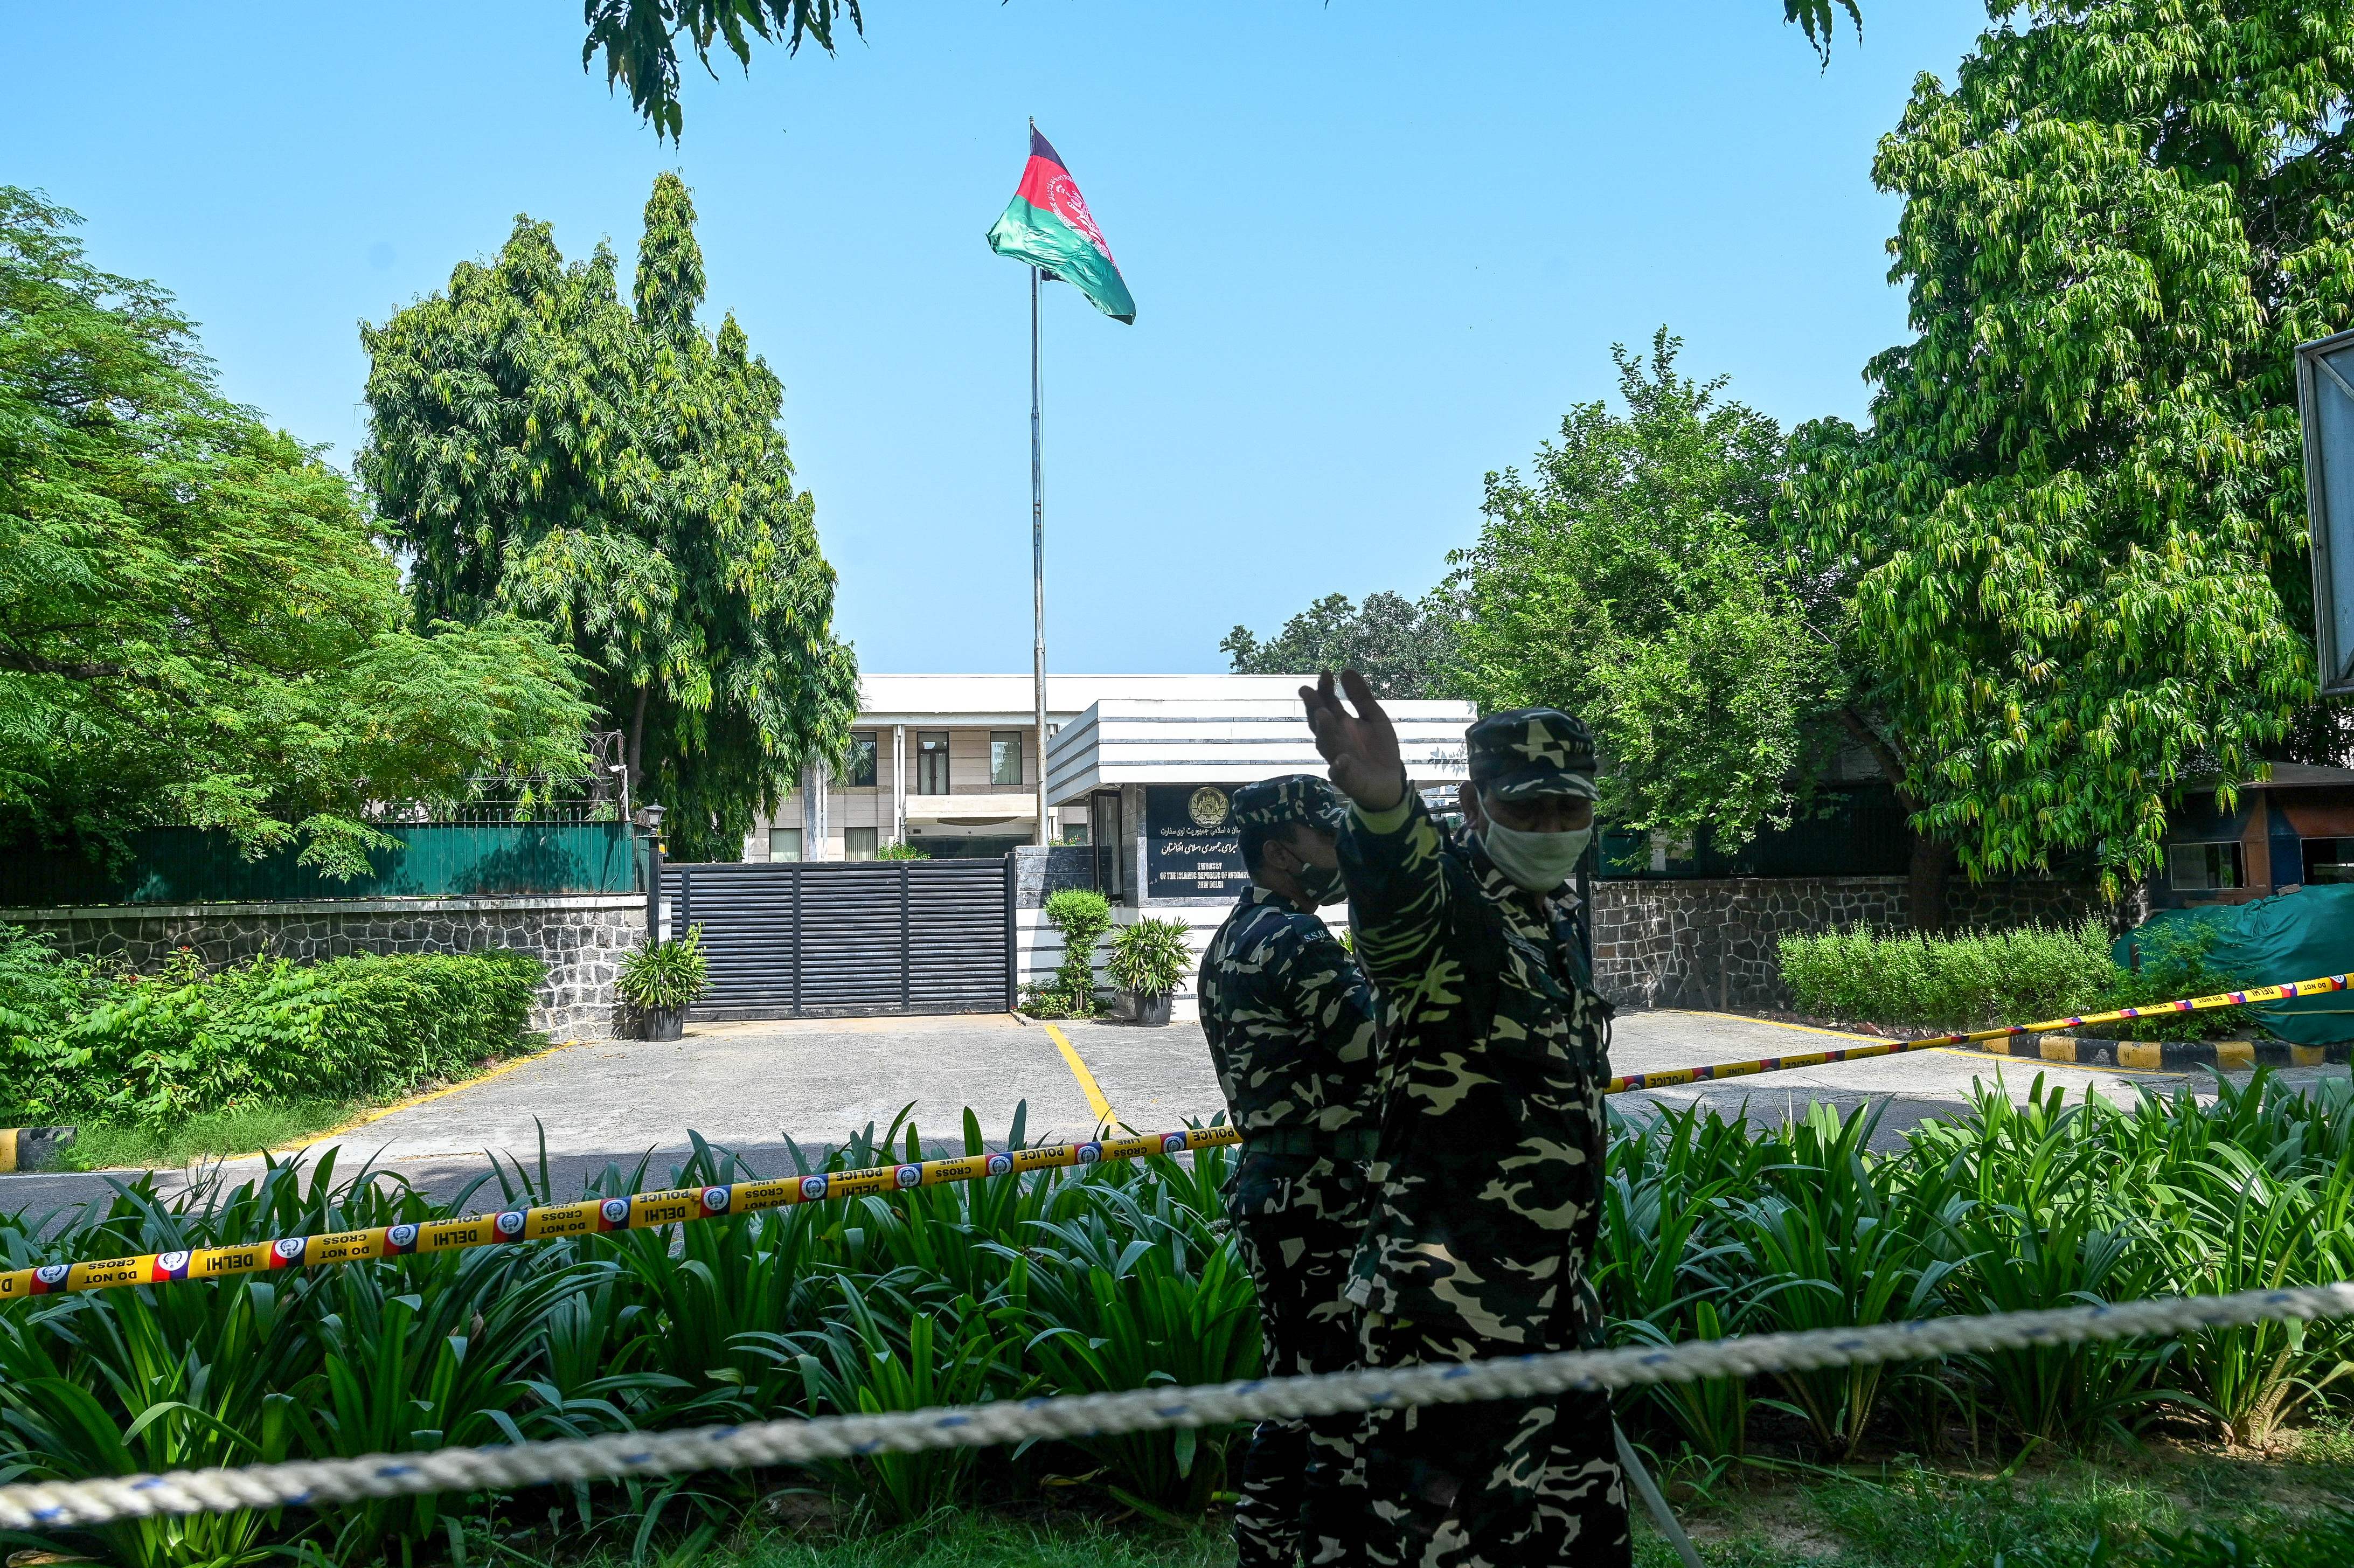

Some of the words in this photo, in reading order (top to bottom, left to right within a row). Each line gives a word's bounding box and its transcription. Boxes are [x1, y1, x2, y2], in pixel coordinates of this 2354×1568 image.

[1197, 862, 1223, 870] EMBASSY
[1159, 872, 1166, 880] OF
[1166, 872, 1176, 880] THE
[1176, 871, 1197, 880] ISLAMIC
[1197, 871, 1220, 879] REPUBLIC
[1197, 880, 1209, 889] NEW
[1209, 880, 1224, 889] DELHI
[1304, 930, 1328, 942] S.S.B.
[1726, 1067, 1745, 1076] LINE
[1192, 1127, 1234, 1141] POLICE
[1019, 1147, 1065, 1161] POLICE
[1113, 1147, 1148, 1157] CROSS
[835, 1168, 883, 1181] POLICE
[935, 1166, 971, 1177] CROSS
[639, 1190, 689, 1203] POLICE
[745, 1187, 783, 1198] CROSS
[742, 1202, 767, 1210] NOT
[541, 1210, 582, 1222] CROSS
[644, 1206, 685, 1223] DELHI
[539, 1224, 565, 1234] NOT
[568, 1222, 586, 1231] DO
[323, 1234, 367, 1245] CROSS
[434, 1229, 477, 1246] DELHI
[320, 1248, 348, 1259] NOT
[351, 1246, 370, 1255] DO
[88, 1259, 136, 1269] CROSS
[206, 1253, 253, 1271] DELHI
[84, 1273, 113, 1283] NOT
[117, 1271, 137, 1280] DO
